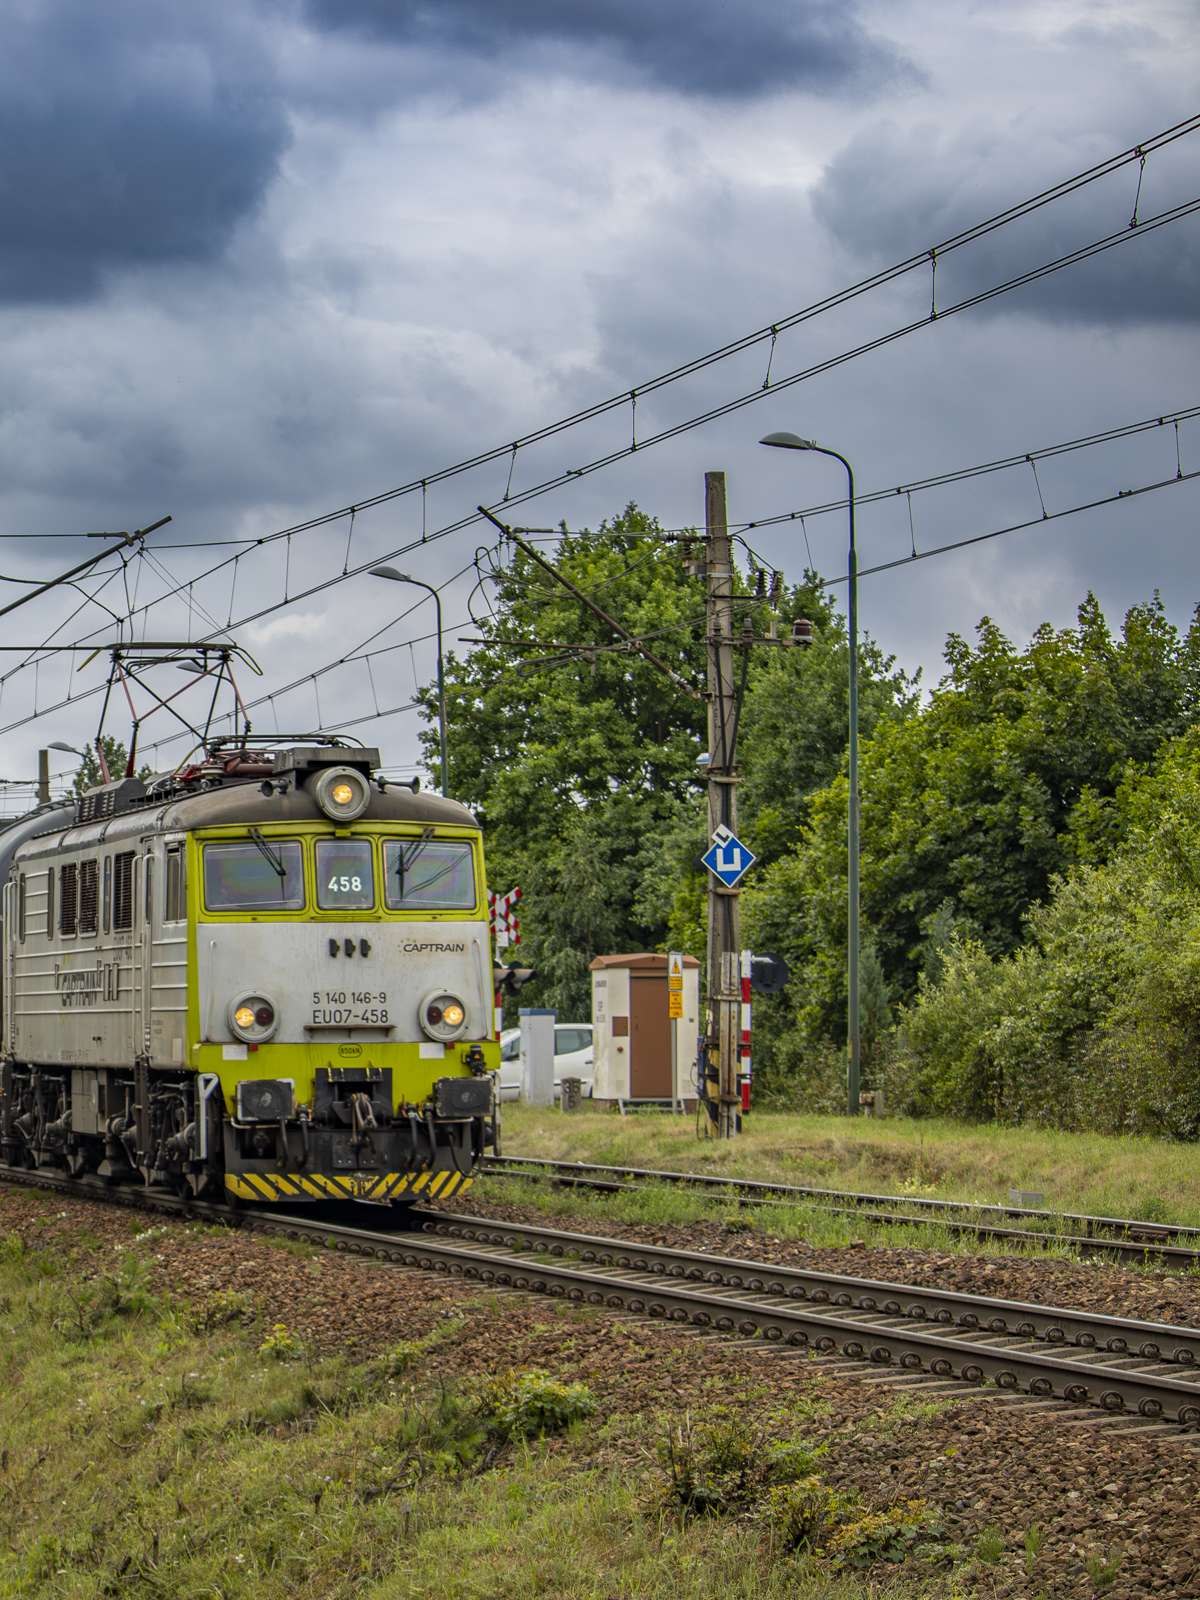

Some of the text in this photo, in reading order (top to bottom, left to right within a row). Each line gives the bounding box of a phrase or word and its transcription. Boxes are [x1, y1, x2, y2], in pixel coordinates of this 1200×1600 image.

[328, 876, 362, 892] 458
[403, 943, 465, 953] CAPTRAIN
[61, 972, 98, 1007] CAPTRAIN
[312, 991, 387, 1005] 5 140 146-9
[312, 1009, 389, 1025] EU07-458
[340, 1047, 360, 1055] 850kN
[563, 1081, 580, 1094] 35
[567, 1095, 576, 1109] 5
